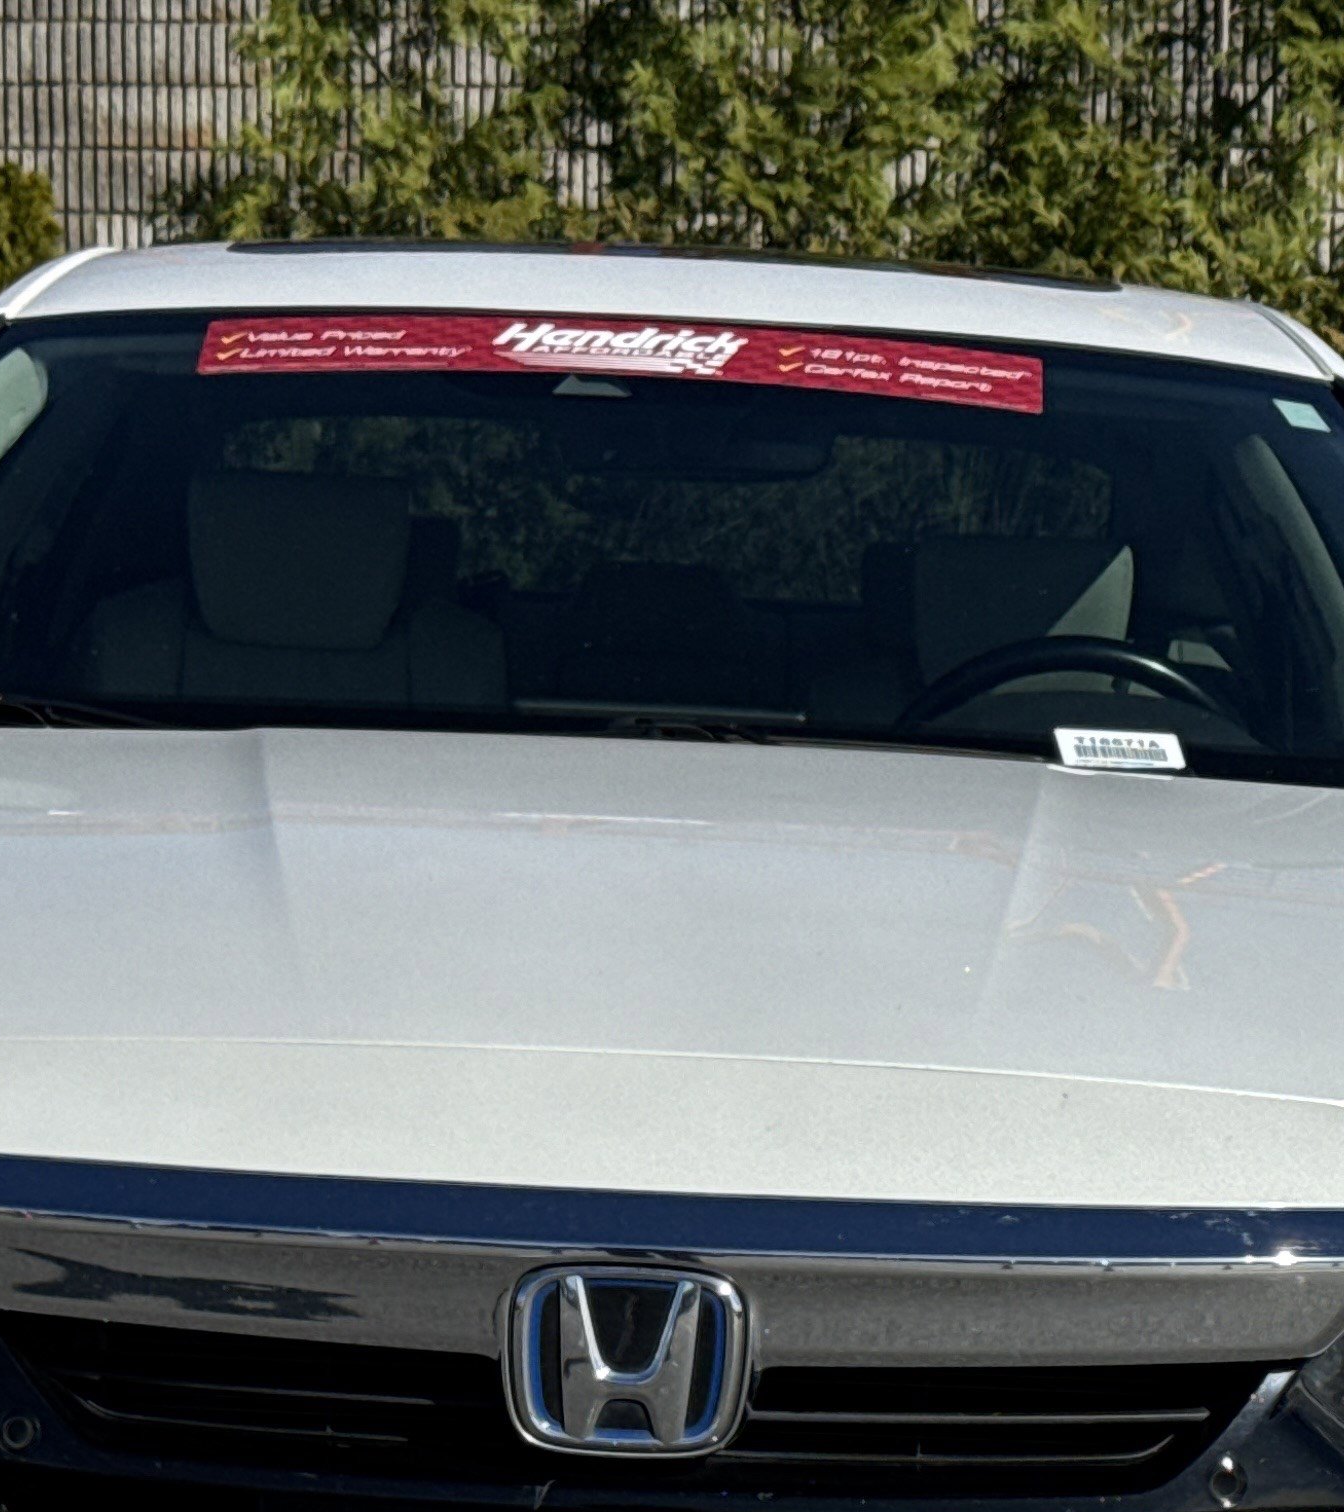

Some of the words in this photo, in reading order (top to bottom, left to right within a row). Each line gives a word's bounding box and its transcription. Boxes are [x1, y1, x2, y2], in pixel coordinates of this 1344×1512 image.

[247, 330, 315, 342] Value
[320, 329, 407, 341] Priced
[492, 322, 749, 354] Hendrick
[240, 346, 336, 359] Limited
[344, 346, 473, 358] Warranty
[804, 364, 892, 381] Carfax
[898, 357, 1032, 379] Inspected
